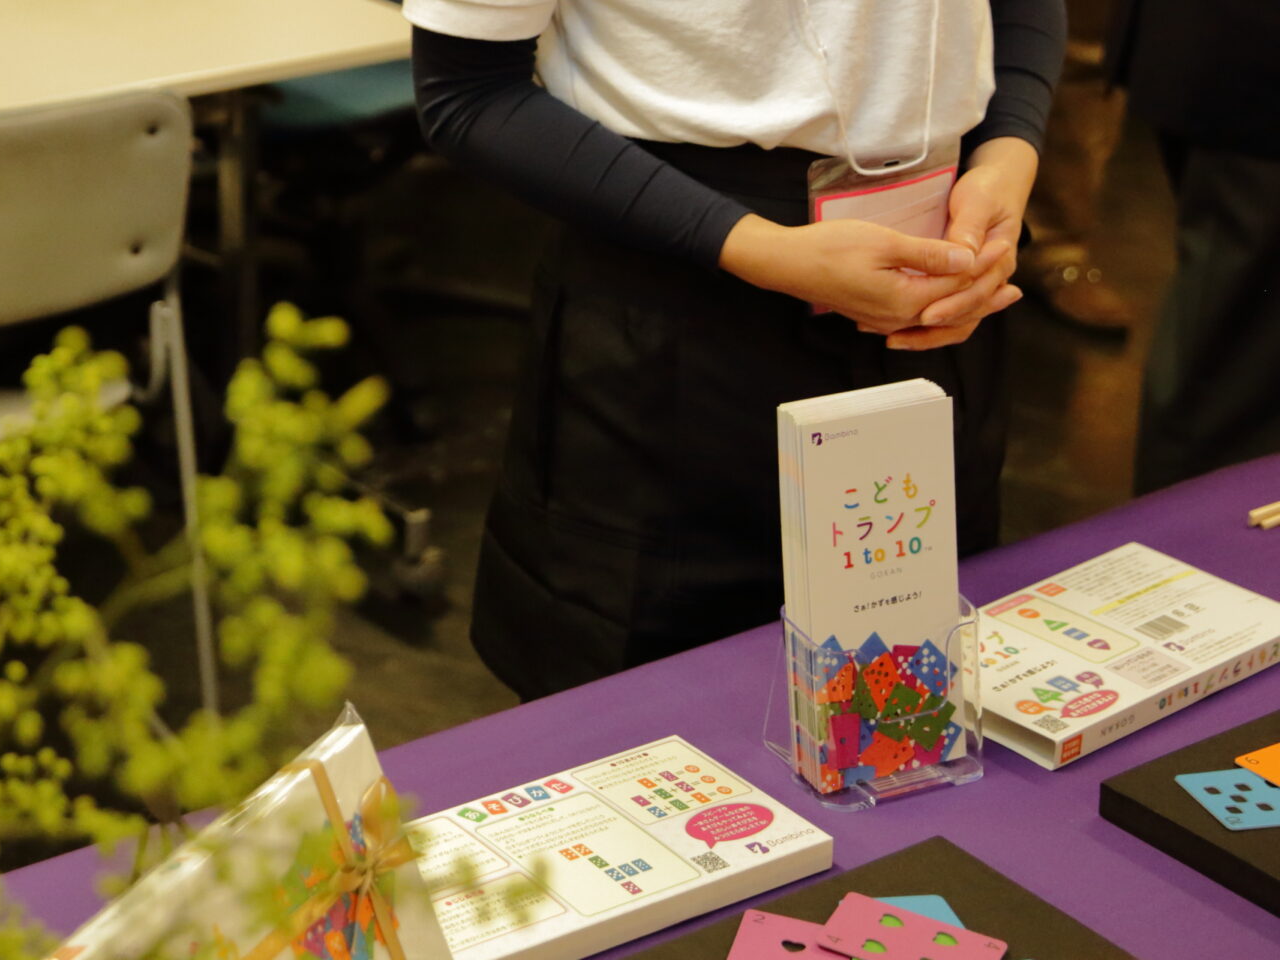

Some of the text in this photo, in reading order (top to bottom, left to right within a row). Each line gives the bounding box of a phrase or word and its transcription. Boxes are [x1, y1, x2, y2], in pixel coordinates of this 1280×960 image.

[844, 472, 919, 510] こども
[832, 499, 936, 548] トランプ
[843, 551, 854, 569] 1
[863, 547, 886, 564] to
[895, 536, 922, 558] 10
[752, 914, 766, 925] 2
